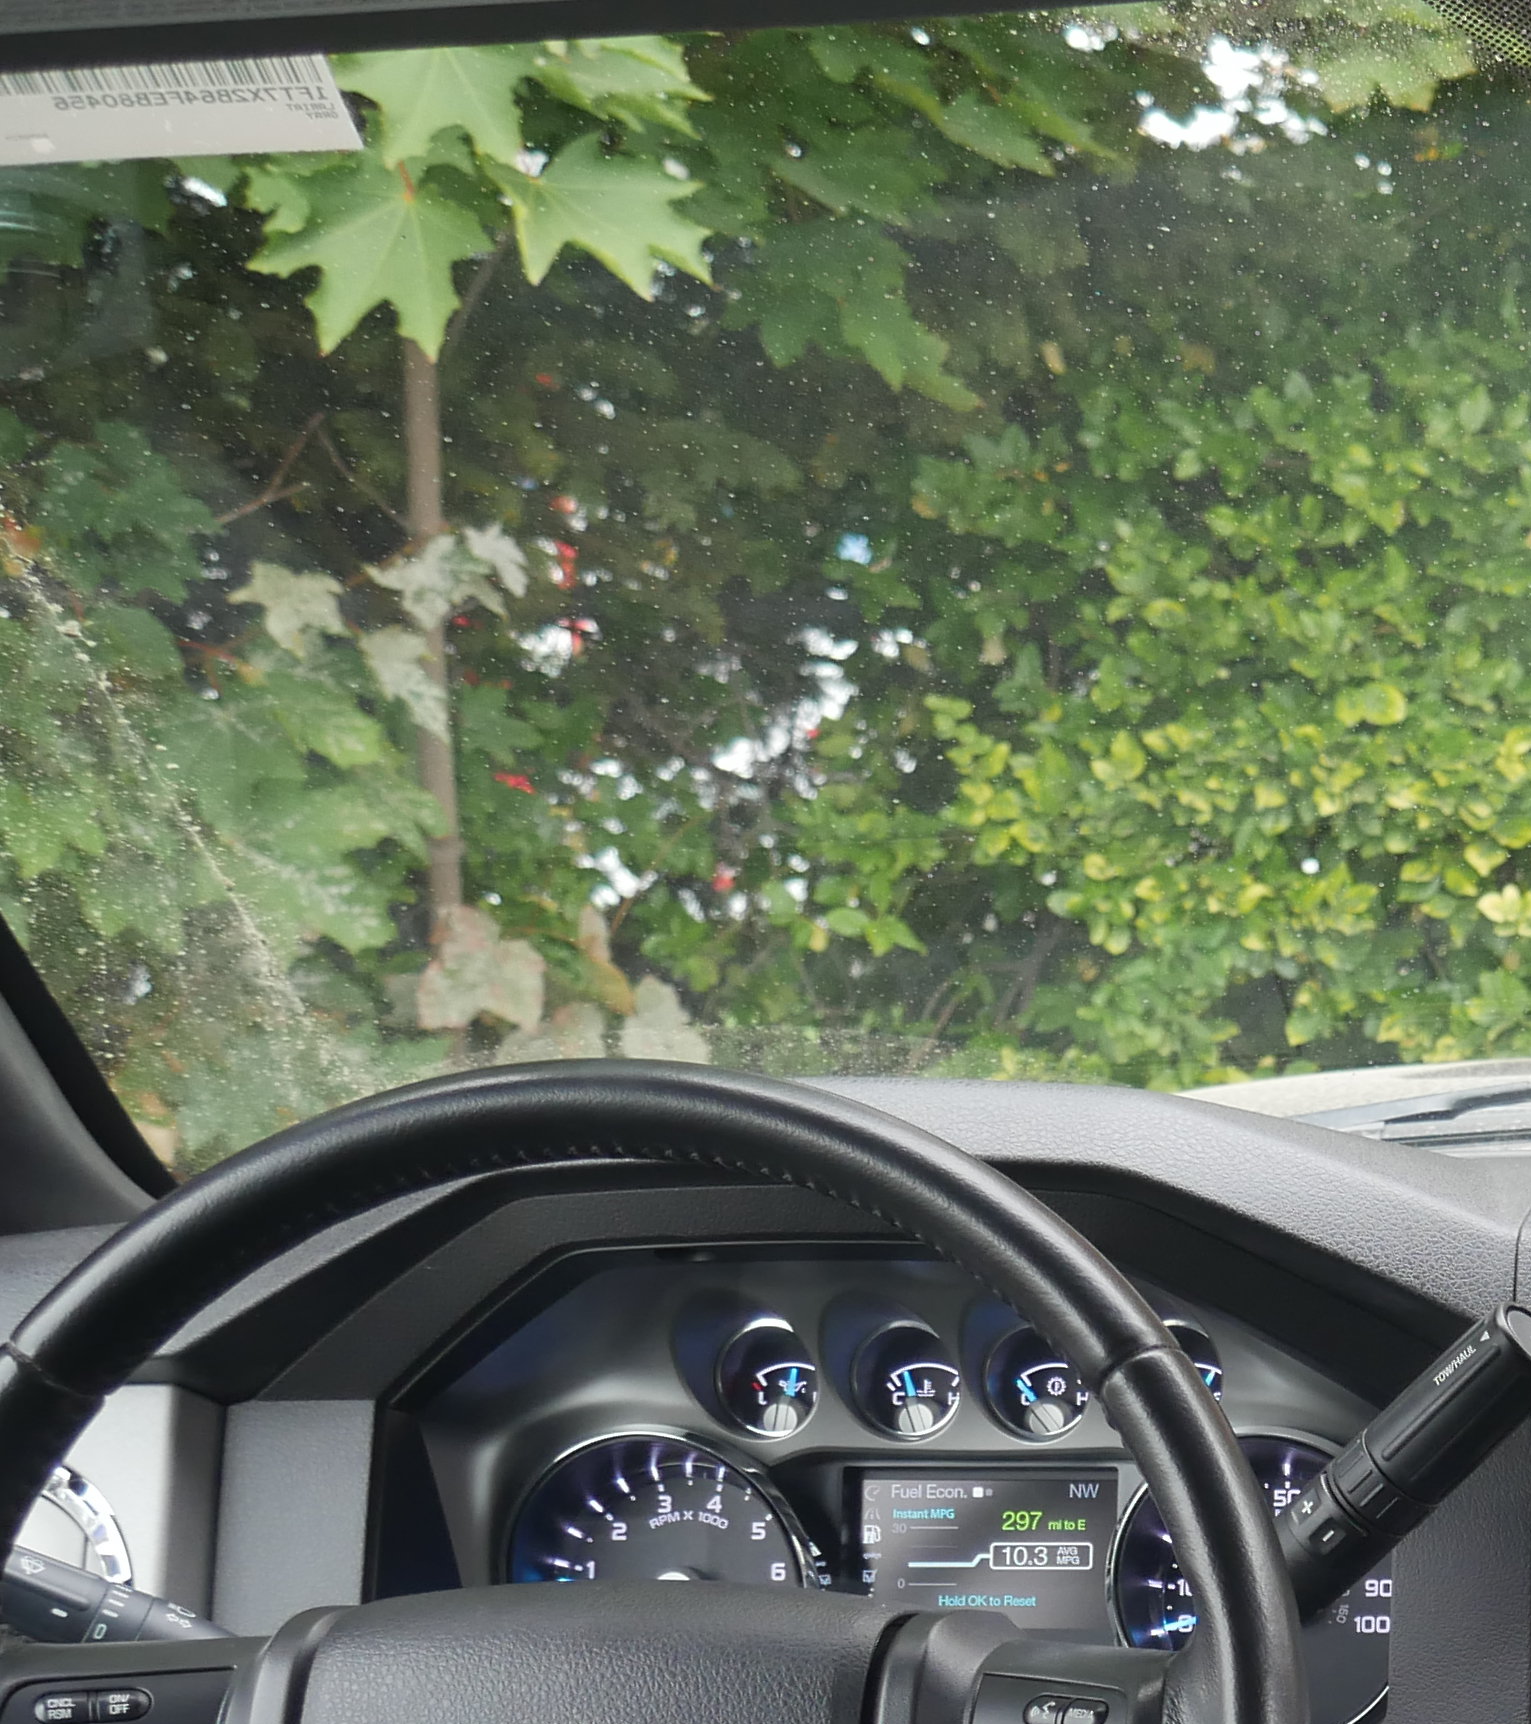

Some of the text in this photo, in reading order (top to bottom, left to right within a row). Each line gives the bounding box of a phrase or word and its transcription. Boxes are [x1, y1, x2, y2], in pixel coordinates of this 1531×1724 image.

[1433, 1345, 1477, 1386] TOW/HAUL
[891, 1484, 968, 1498] Fuel Econ.
[1069, 1484, 1099, 1498] NW
[658, 1495, 672, 1513] 3
[706, 1495, 722, 1513] 4
[649, 1512, 680, 1530] RPM
[699, 1511, 729, 1530] 1000
[893, 1509, 955, 1519] Instant MPG
[1002, 1511, 1086, 1531] 297 mi to E
[611, 1523, 627, 1541] 2
[751, 1522, 766, 1540] 5
[892, 1524, 907, 1534] 30
[1002, 1547, 1048, 1565] 10.3
[1057, 1546, 1078, 1555] AVG
[1057, 1556, 1080, 1565] MPG
[586, 1560, 595, 1580] 1
[770, 1563, 786, 1581] 6
[897, 1578, 905, 1589] 0
[1365, 1580, 1393, 1597] 90
[938, 1595, 1036, 1607] Hold OK to Reset
[1354, 1616, 1390, 1633] 100
